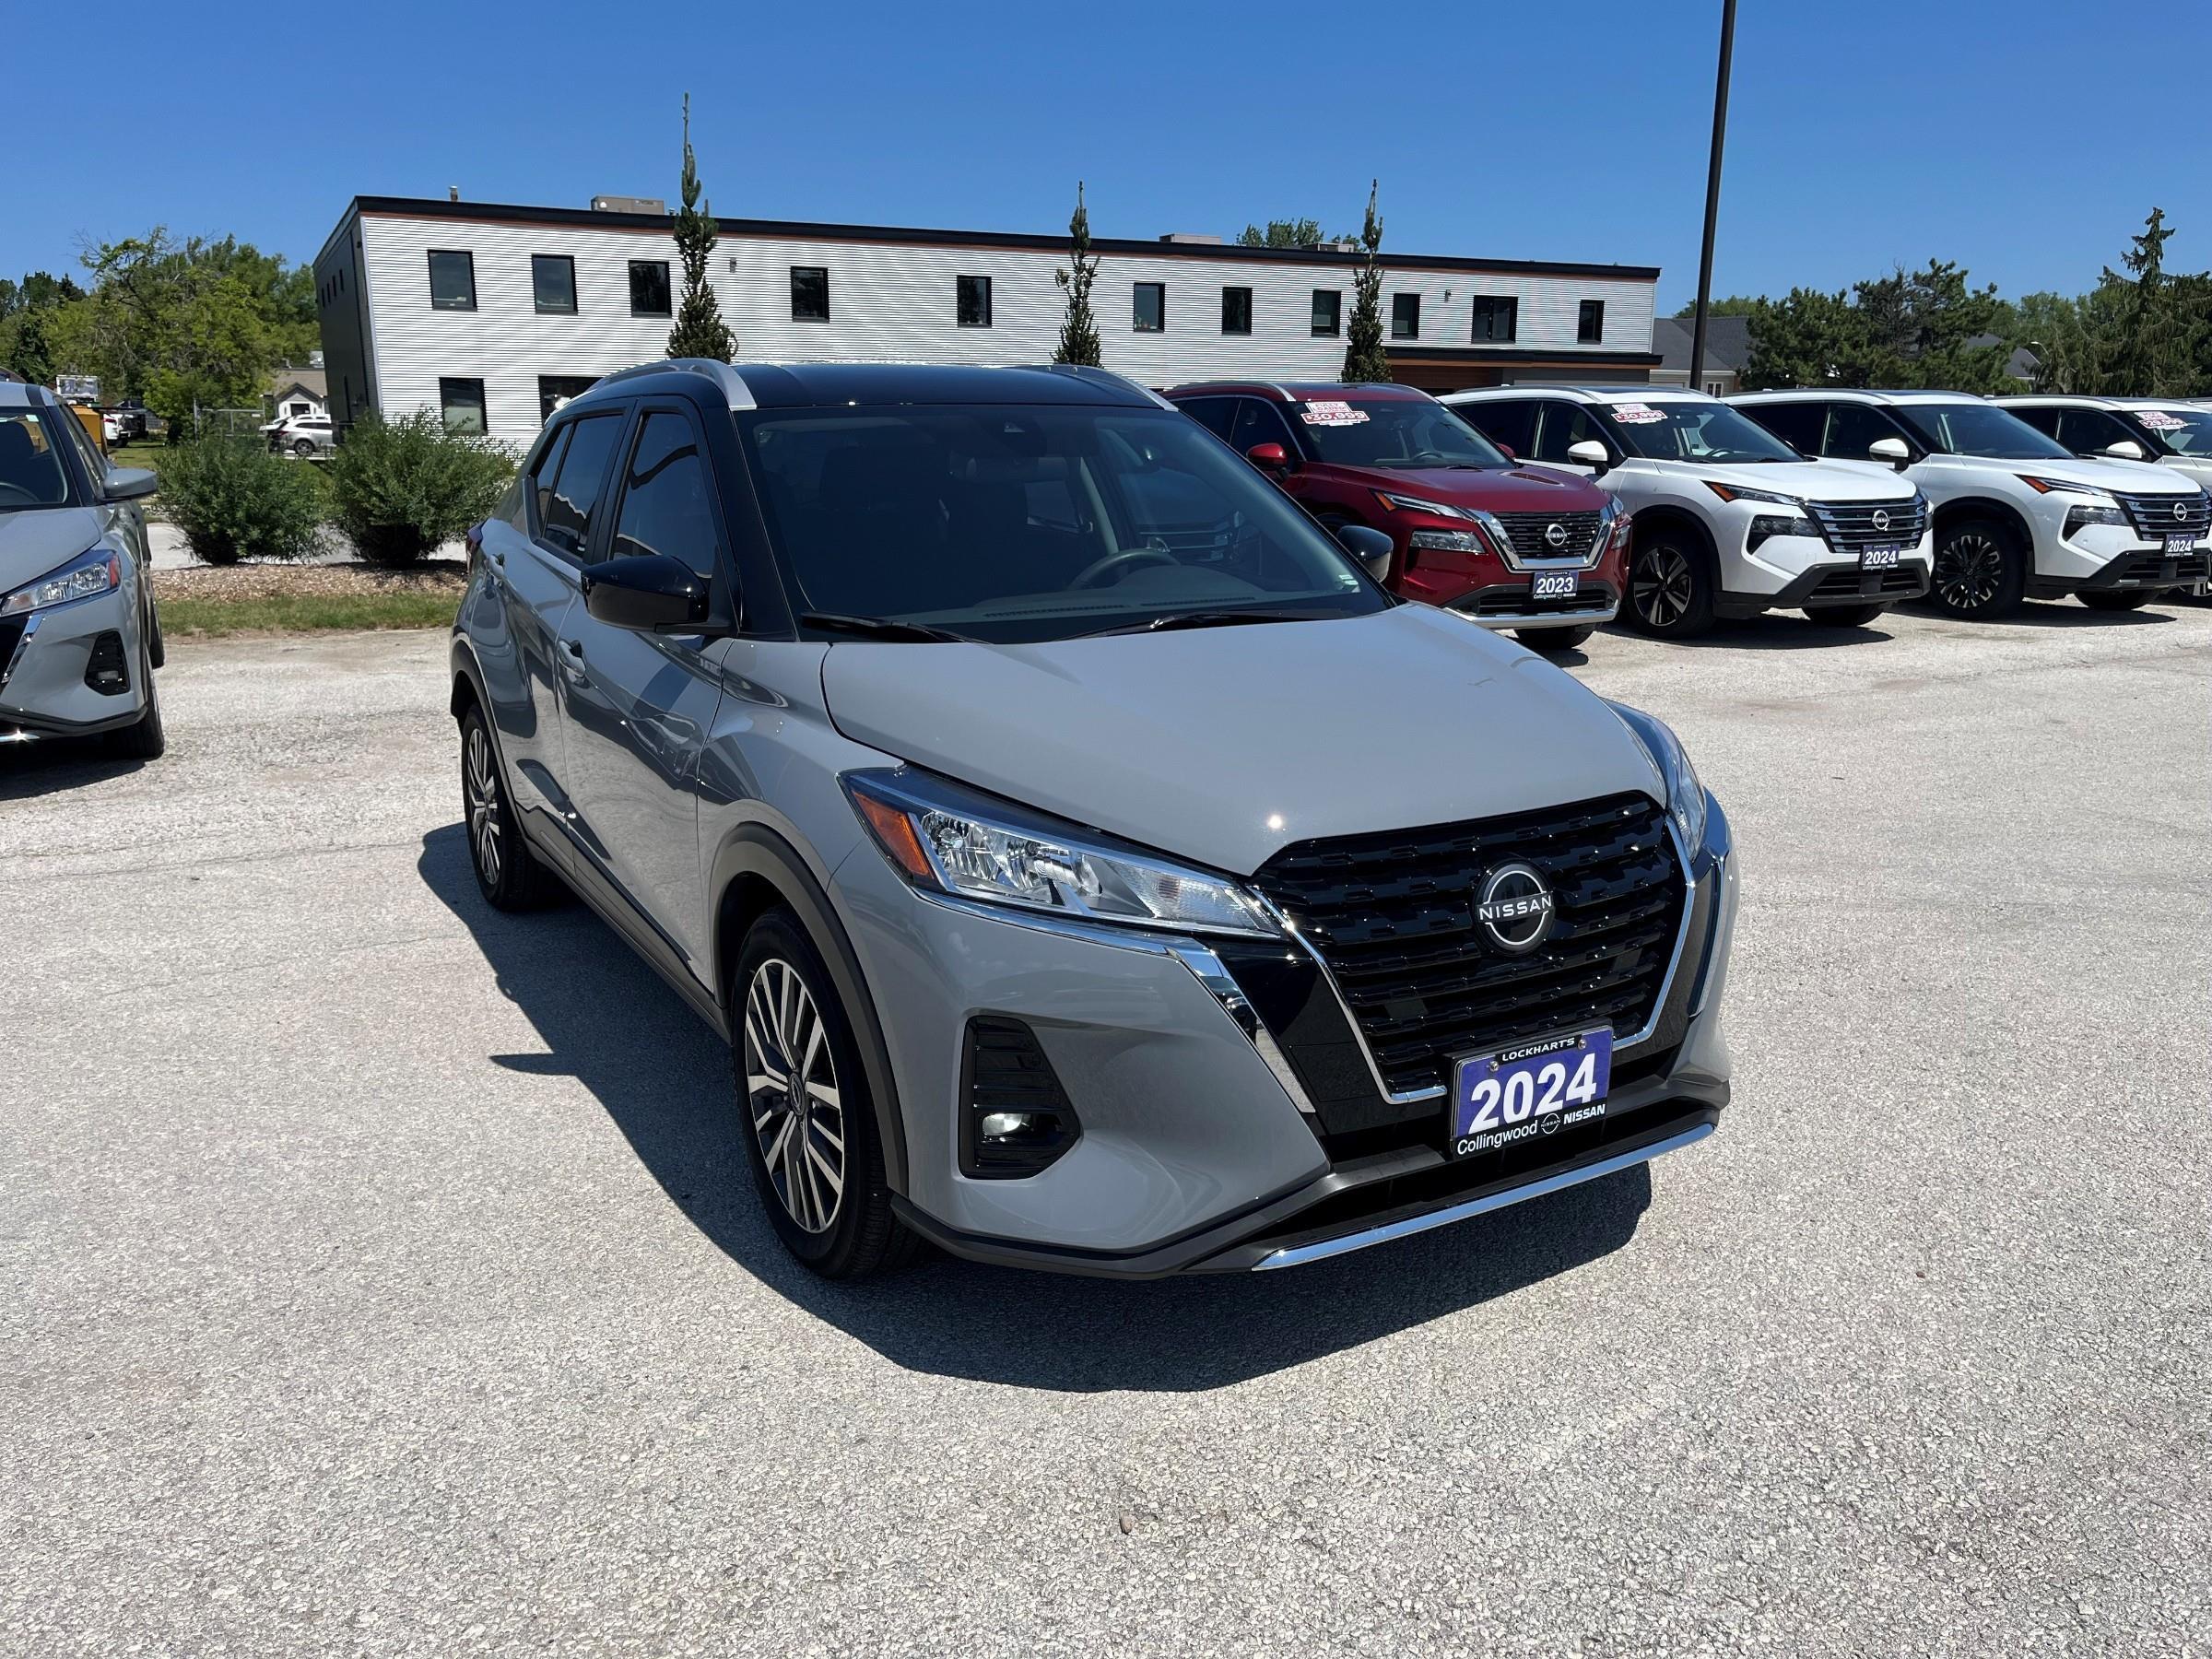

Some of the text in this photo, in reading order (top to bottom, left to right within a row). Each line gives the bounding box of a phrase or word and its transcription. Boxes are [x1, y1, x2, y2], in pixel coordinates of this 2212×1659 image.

[1306, 412, 1365, 421] $30,999
[2168, 540, 2192, 552] 2024
[1865, 550, 1897, 565] 2024
[1536, 577, 1574, 594] 2023
[1478, 895, 1552, 921] NISSAN
[1468, 1053, 1597, 1135] 2024
[1457, 1120, 1538, 1155] Collingwood
[1563, 1103, 1606, 1124] NISSAN
